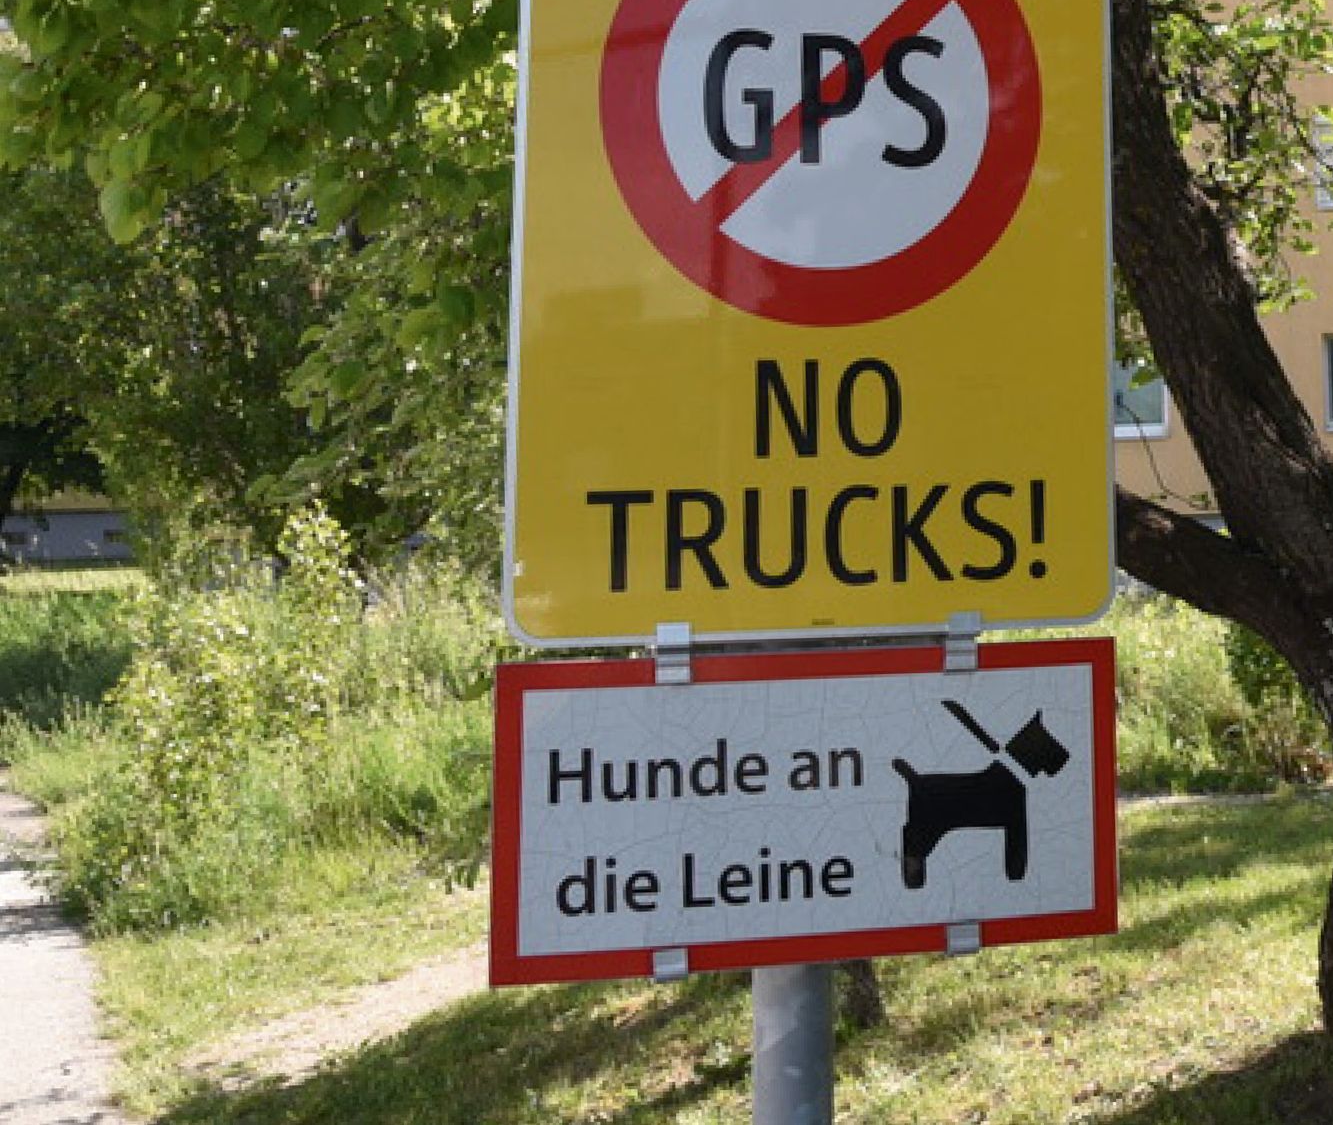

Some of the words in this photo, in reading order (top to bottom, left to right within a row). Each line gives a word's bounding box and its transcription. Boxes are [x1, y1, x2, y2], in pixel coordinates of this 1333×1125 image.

[703, 29, 947, 169] GPS
[754, 358, 902, 459] NO
[586, 479, 1046, 593] TRUCKS!
[548, 738, 768, 805] Hunde
[788, 747, 864, 789] an
[556, 856, 659, 916] die
[682, 848, 854, 909] Leine
